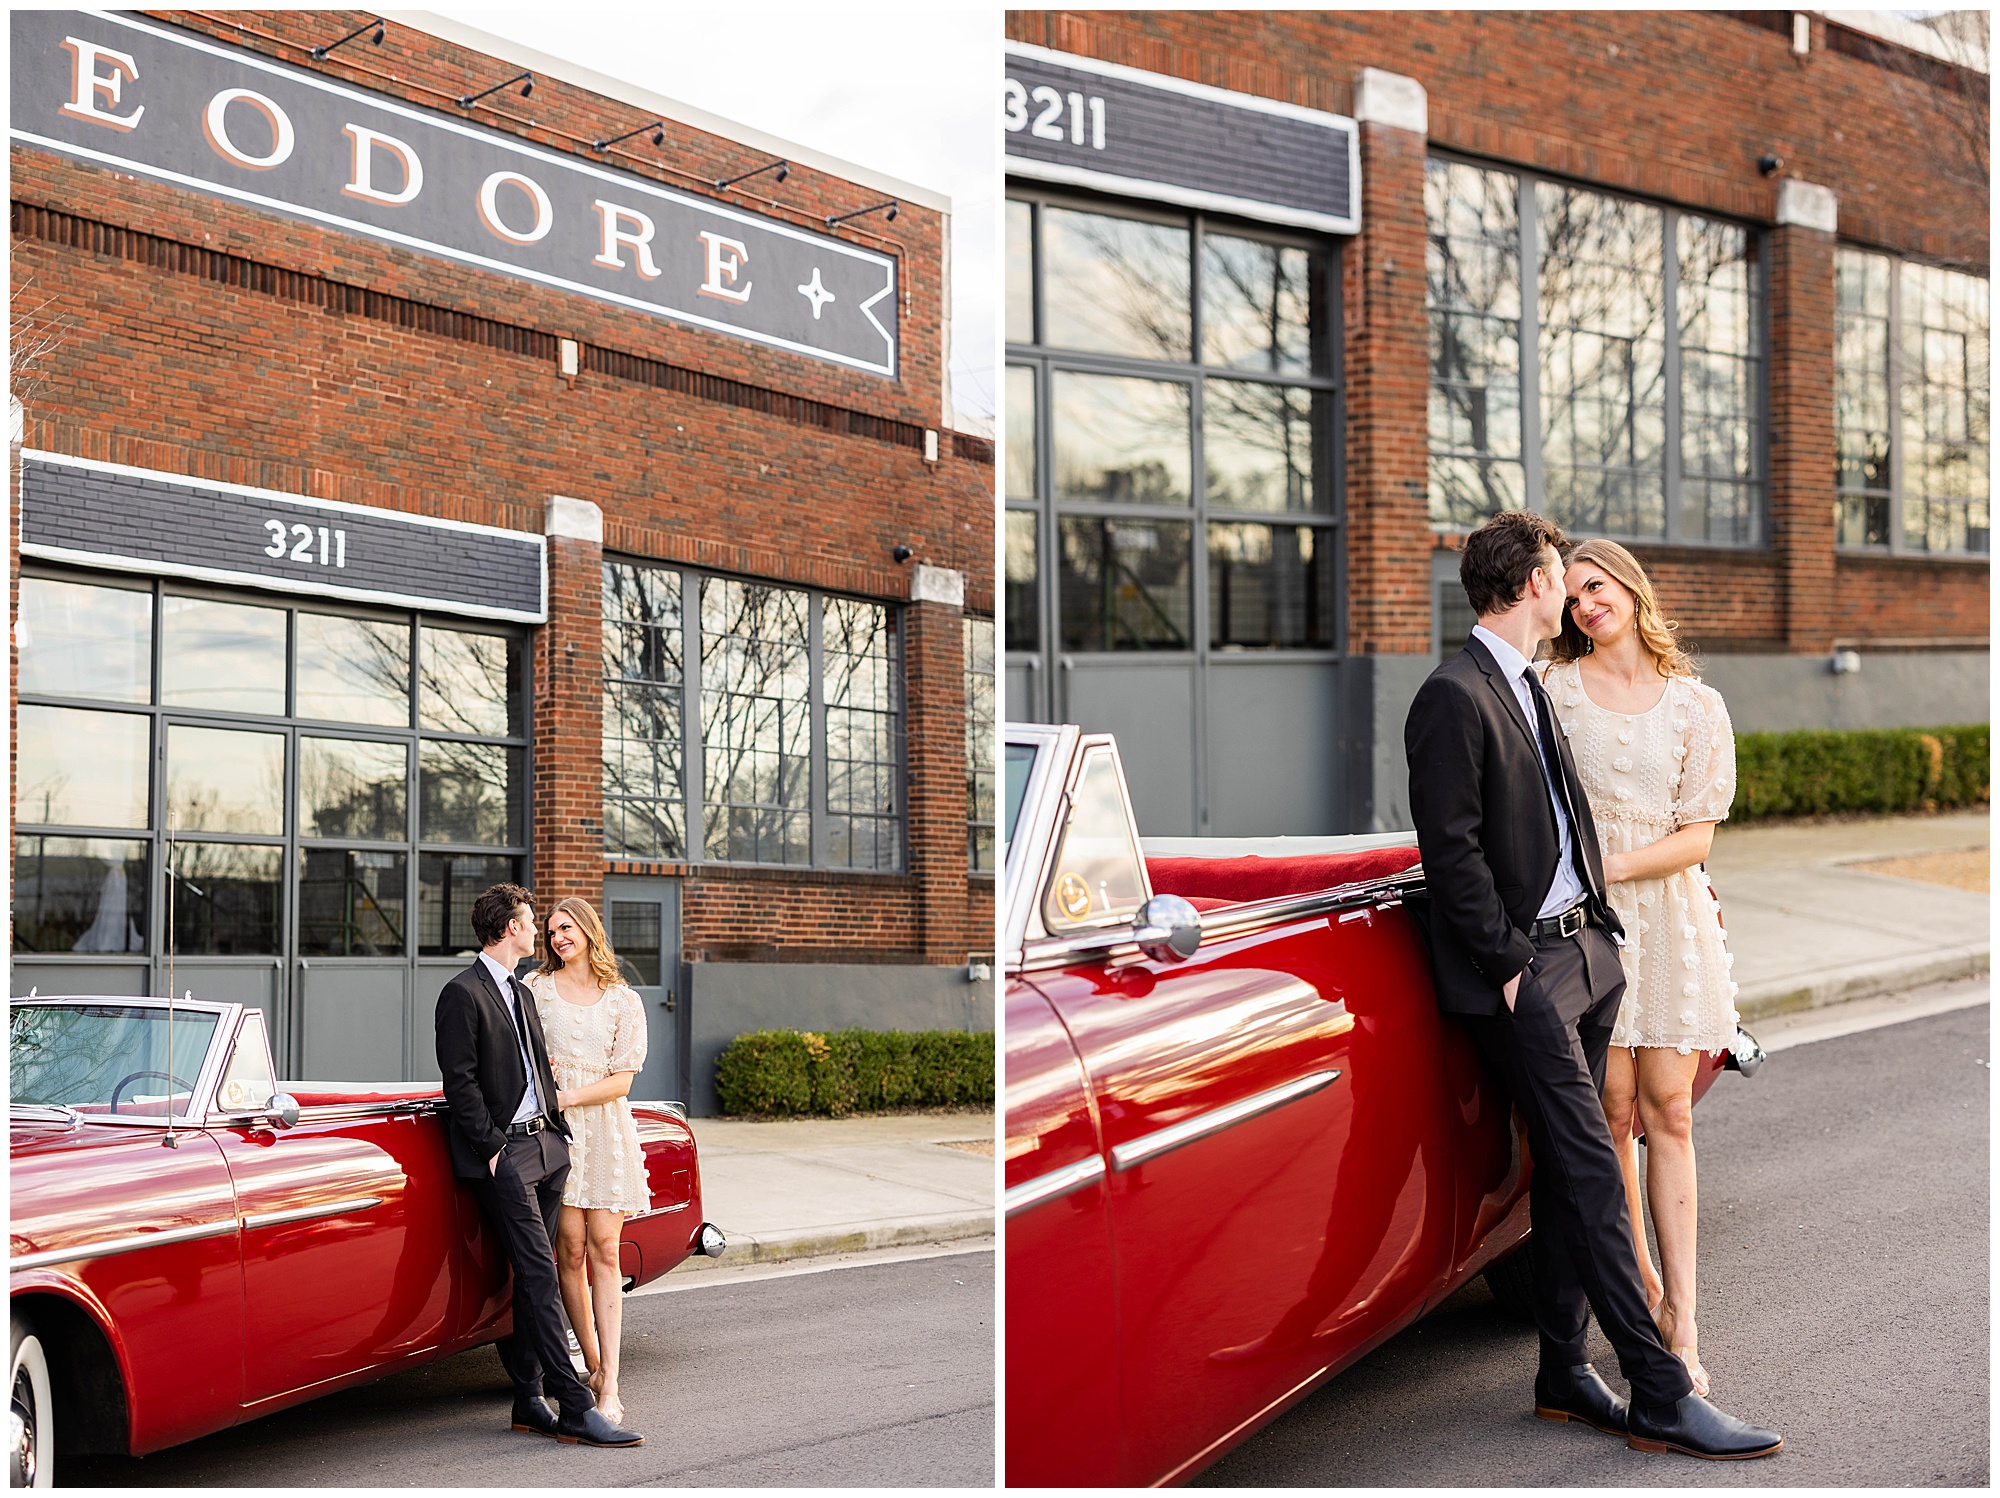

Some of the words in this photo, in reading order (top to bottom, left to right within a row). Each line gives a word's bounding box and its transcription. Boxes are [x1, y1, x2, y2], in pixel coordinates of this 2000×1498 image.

[1005, 77, 1106, 150] 3211
[60, 36, 753, 304] EODORE
[264, 519, 346, 568] 3211
